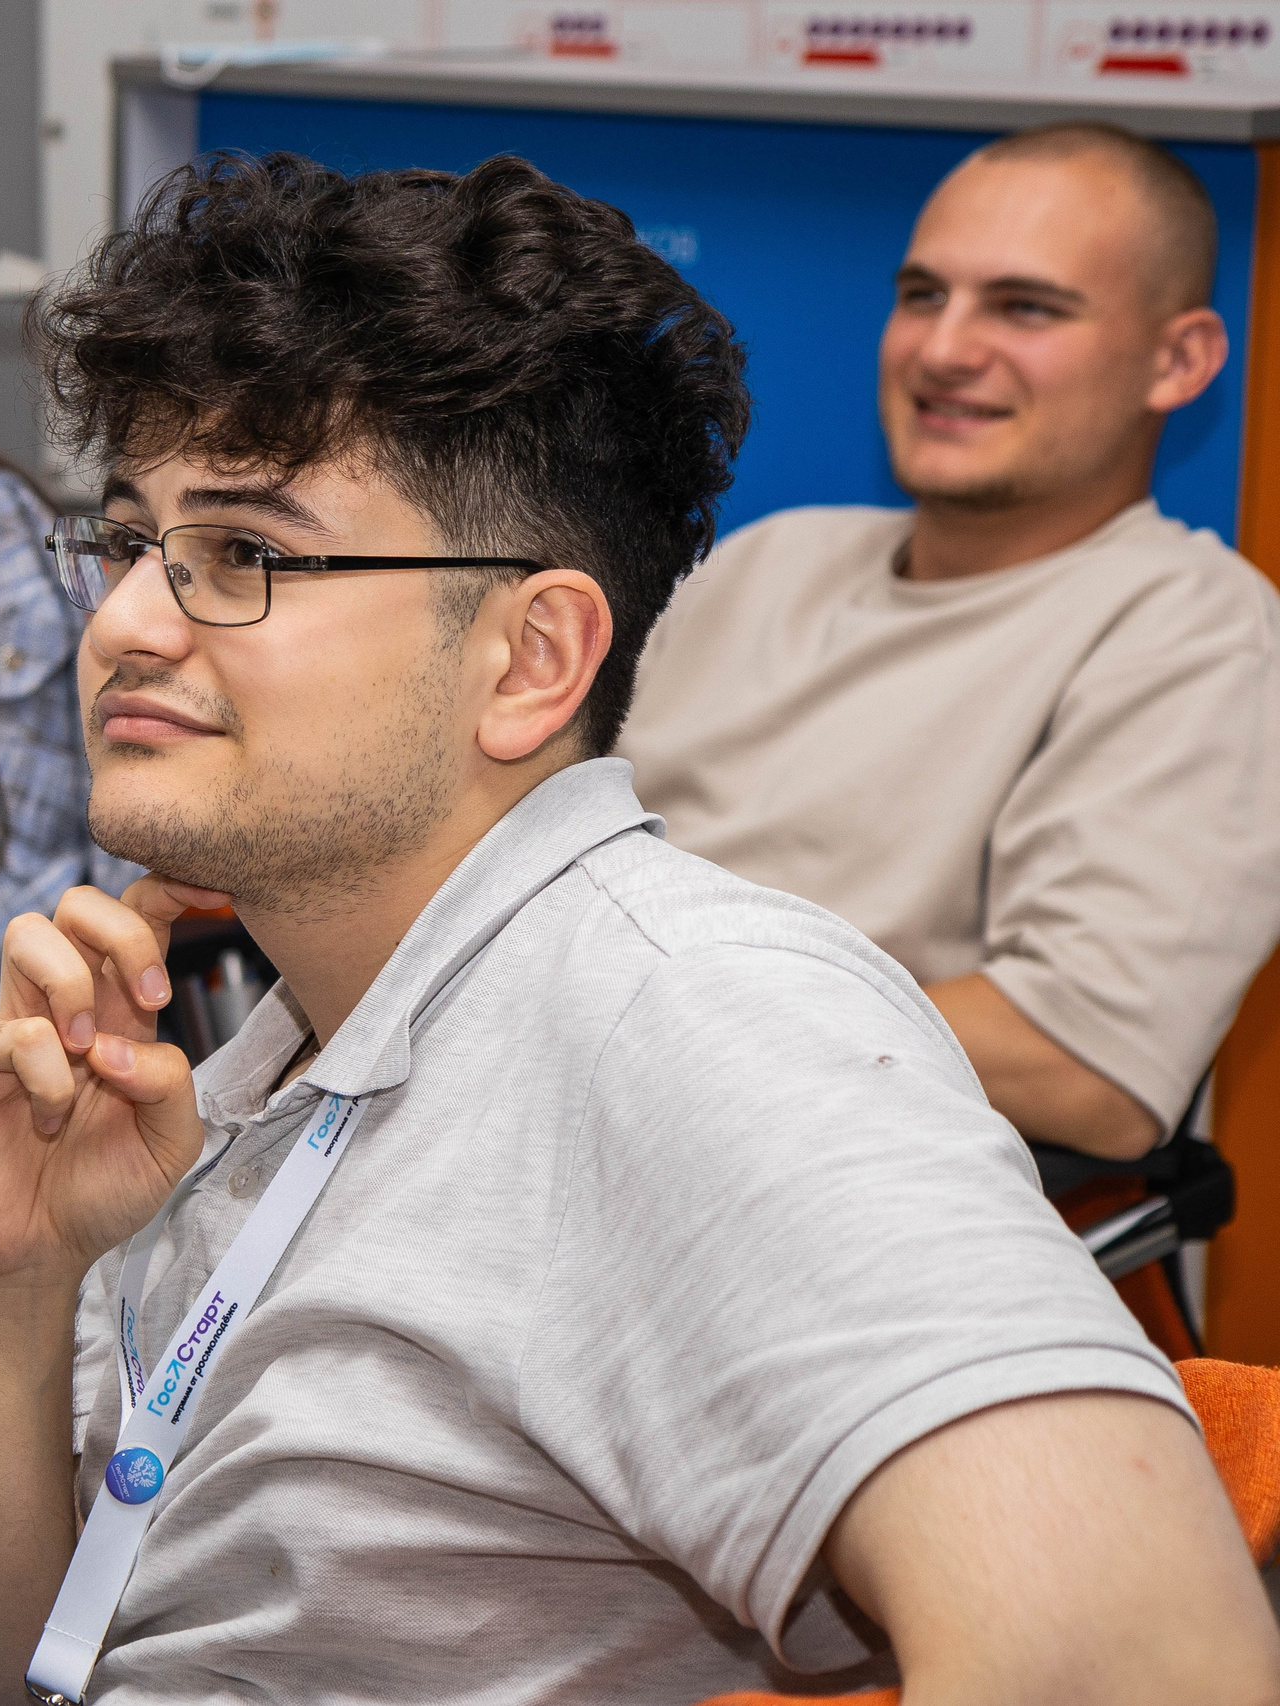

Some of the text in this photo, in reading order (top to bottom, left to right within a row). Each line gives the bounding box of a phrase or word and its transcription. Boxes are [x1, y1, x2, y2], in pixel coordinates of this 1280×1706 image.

[170, 1301, 239, 1426] программа от росмолодёжь
